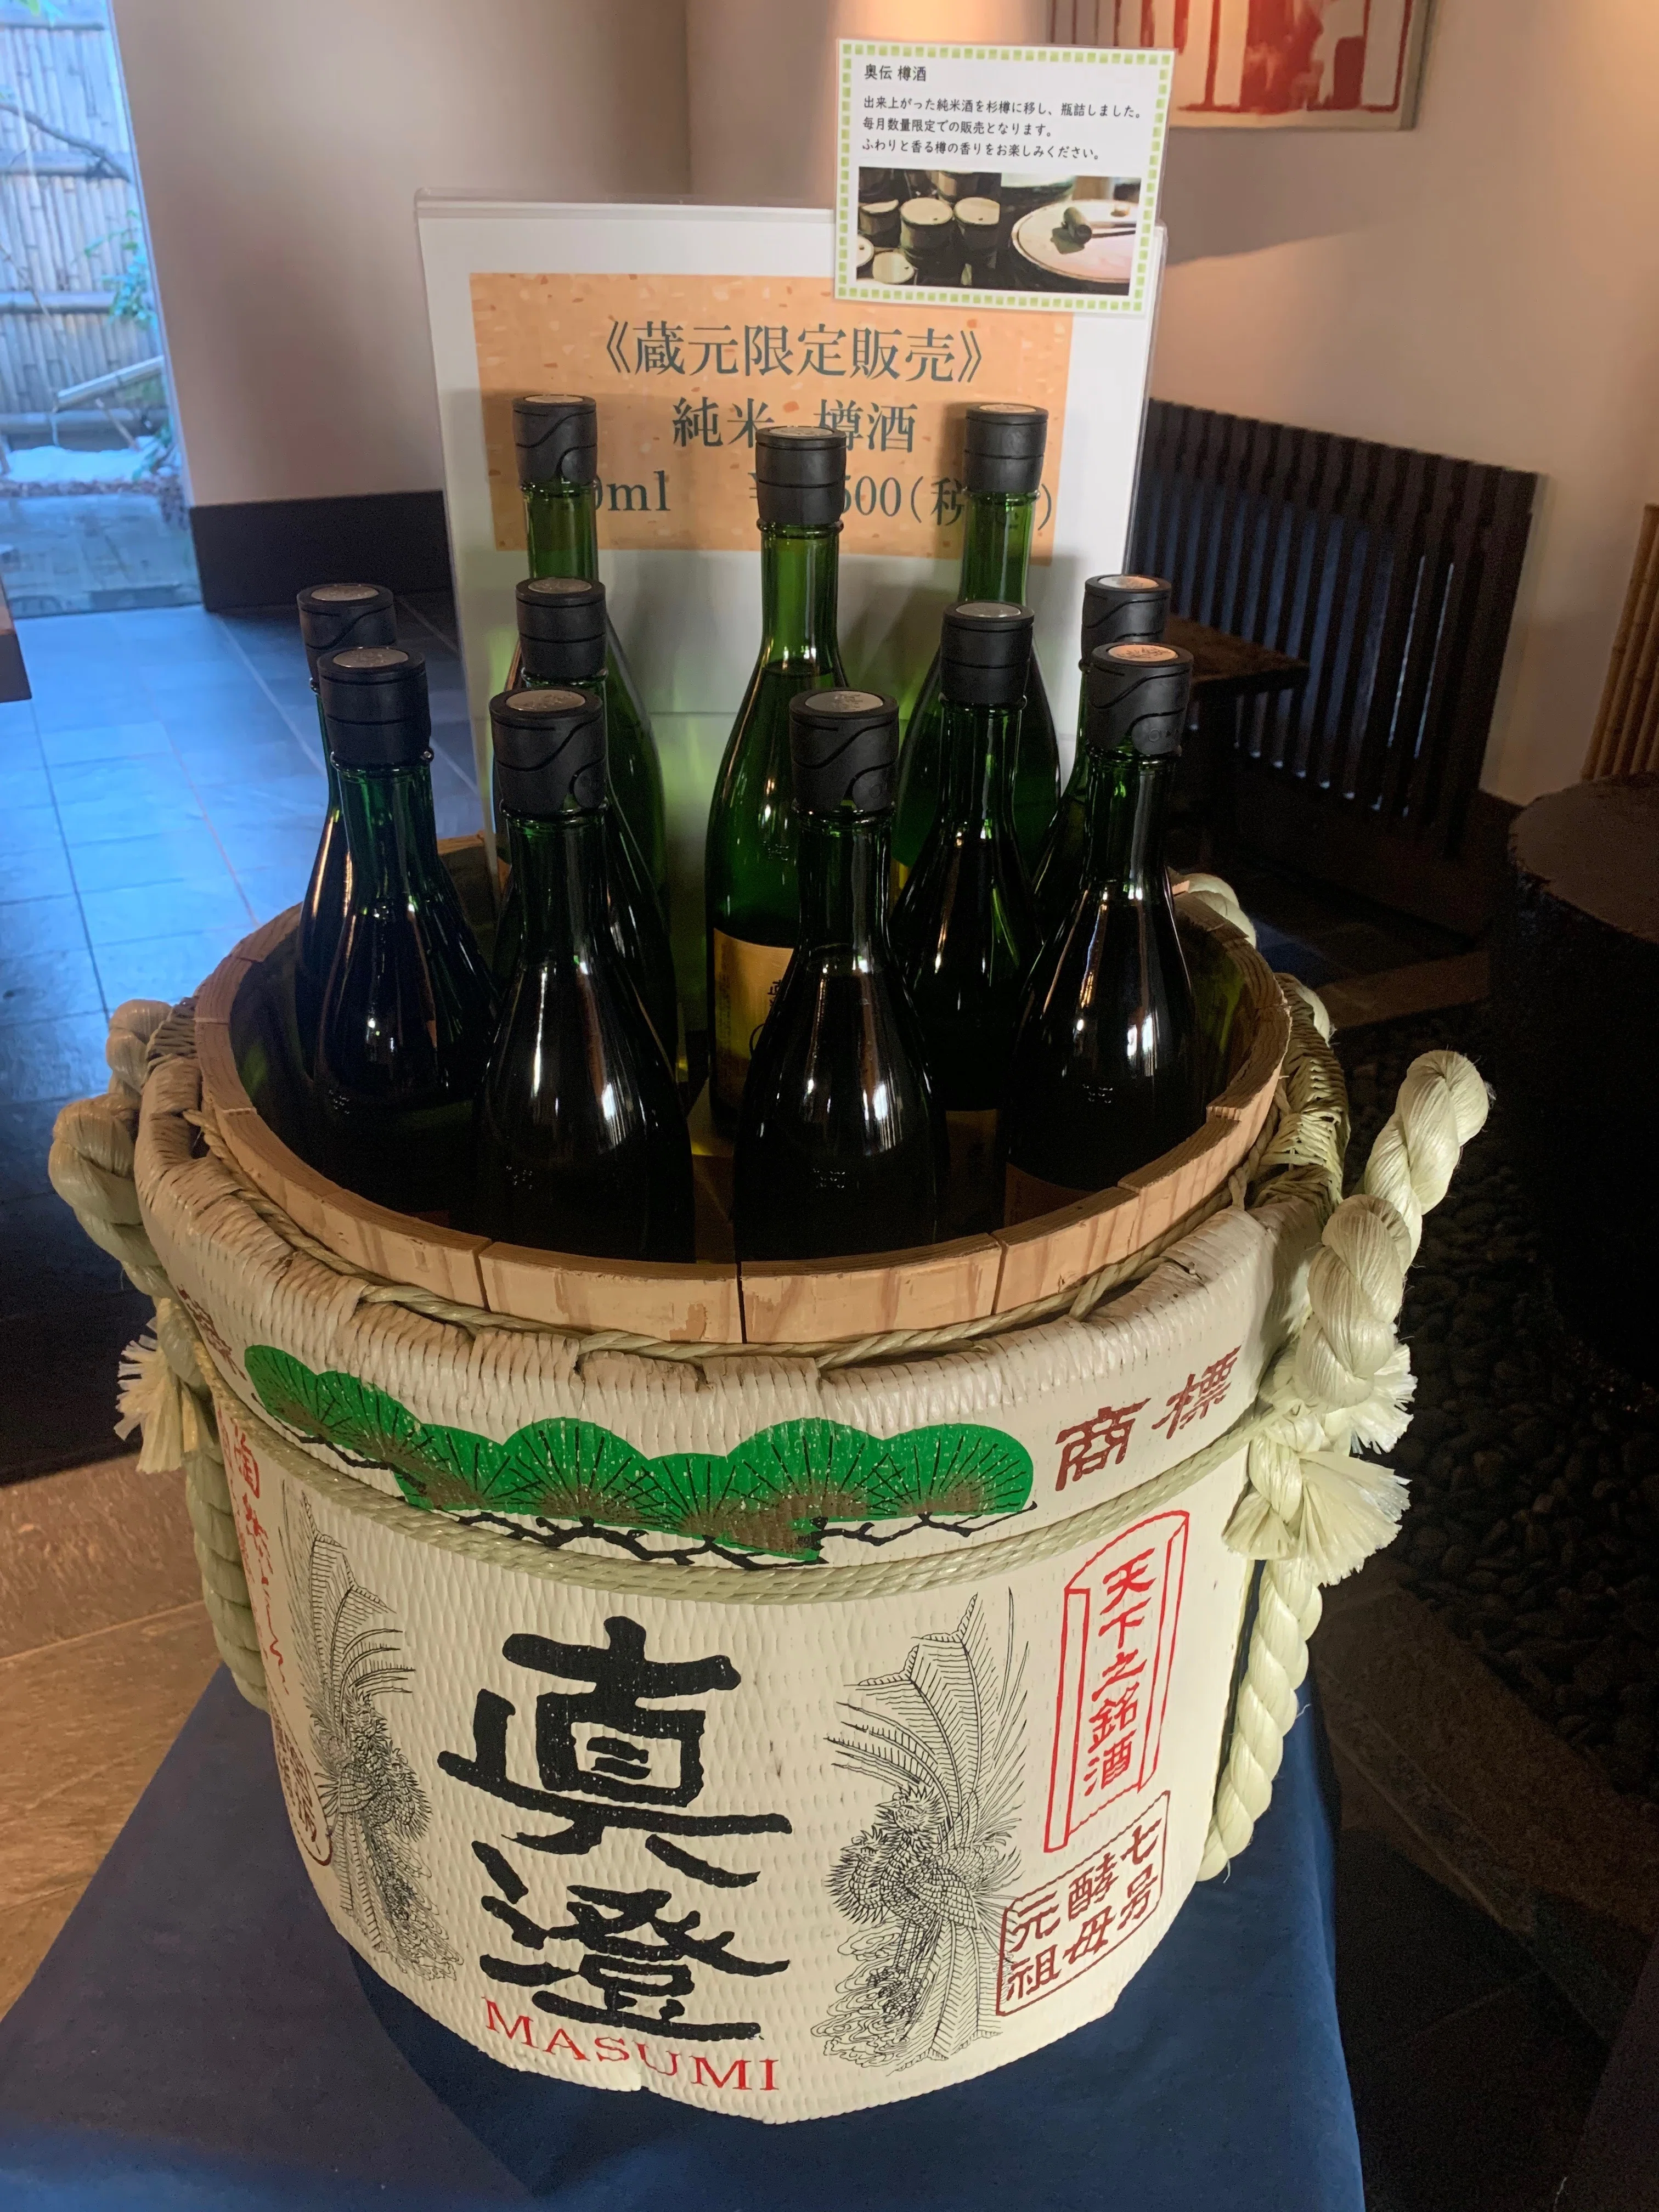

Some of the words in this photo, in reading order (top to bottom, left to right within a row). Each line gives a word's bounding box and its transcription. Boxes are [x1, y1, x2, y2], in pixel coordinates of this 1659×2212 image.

[864, 64, 893, 80] 奥伝
[898, 65, 927, 82] 樽酒
[862, 116, 1051, 137] 毎月数量限定での販売となります。
[864, 95, 1140, 118] 出来上がった純米酒を杉樽に移し、瓶詰しました。
[862, 138, 1098, 160] ふわりと香る樽の香りをお楽しみください。
[605, 320, 983, 383] 《蔵元限定販売》
[672, 396, 775, 448] 純米
[813, 398, 918, 453] 樽酒
[595, 470, 670, 511] ml
[1054, 1345, 1242, 1492] 商標
[1084, 1547, 1157, 1797] 天下之銘酒
[481, 1995, 779, 2091] MASUMI
